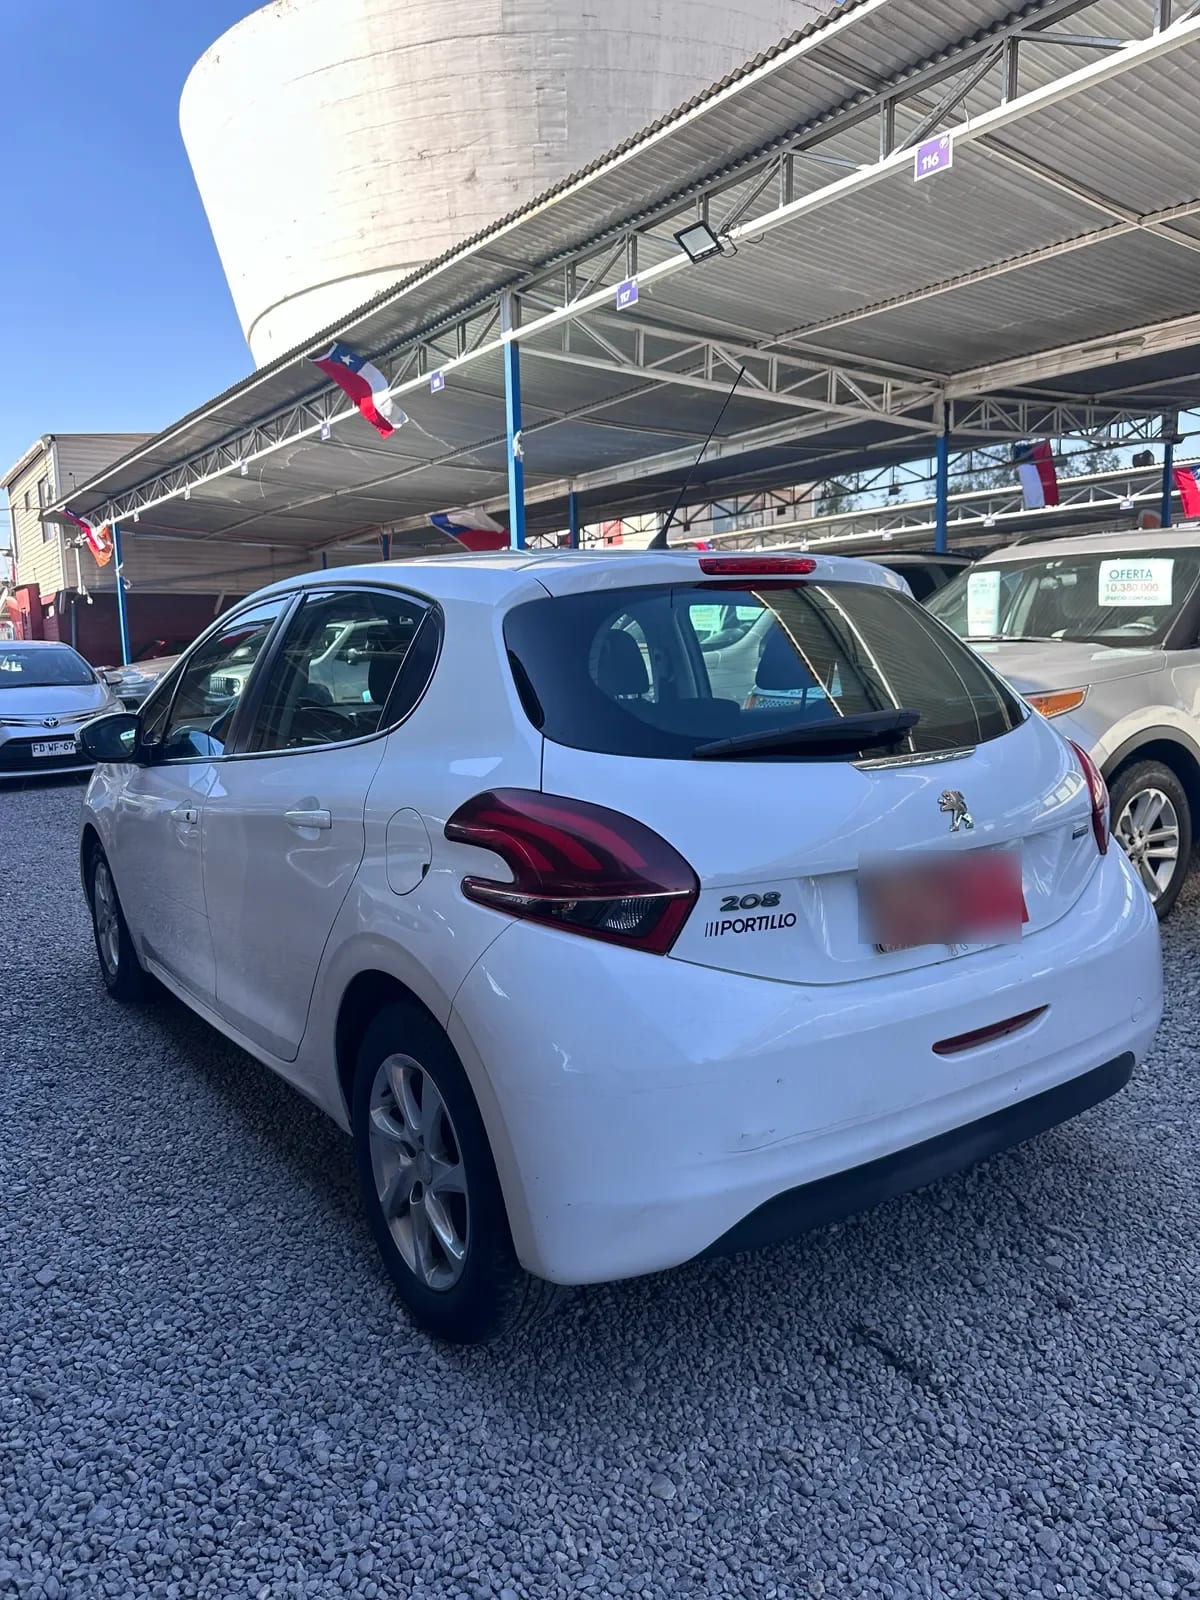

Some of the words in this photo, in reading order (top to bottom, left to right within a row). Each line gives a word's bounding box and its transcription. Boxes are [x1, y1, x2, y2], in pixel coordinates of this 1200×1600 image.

[922, 152, 940, 170] 116
[1109, 569, 1153, 580] OFERTA
[720, 891, 781, 912] 208
